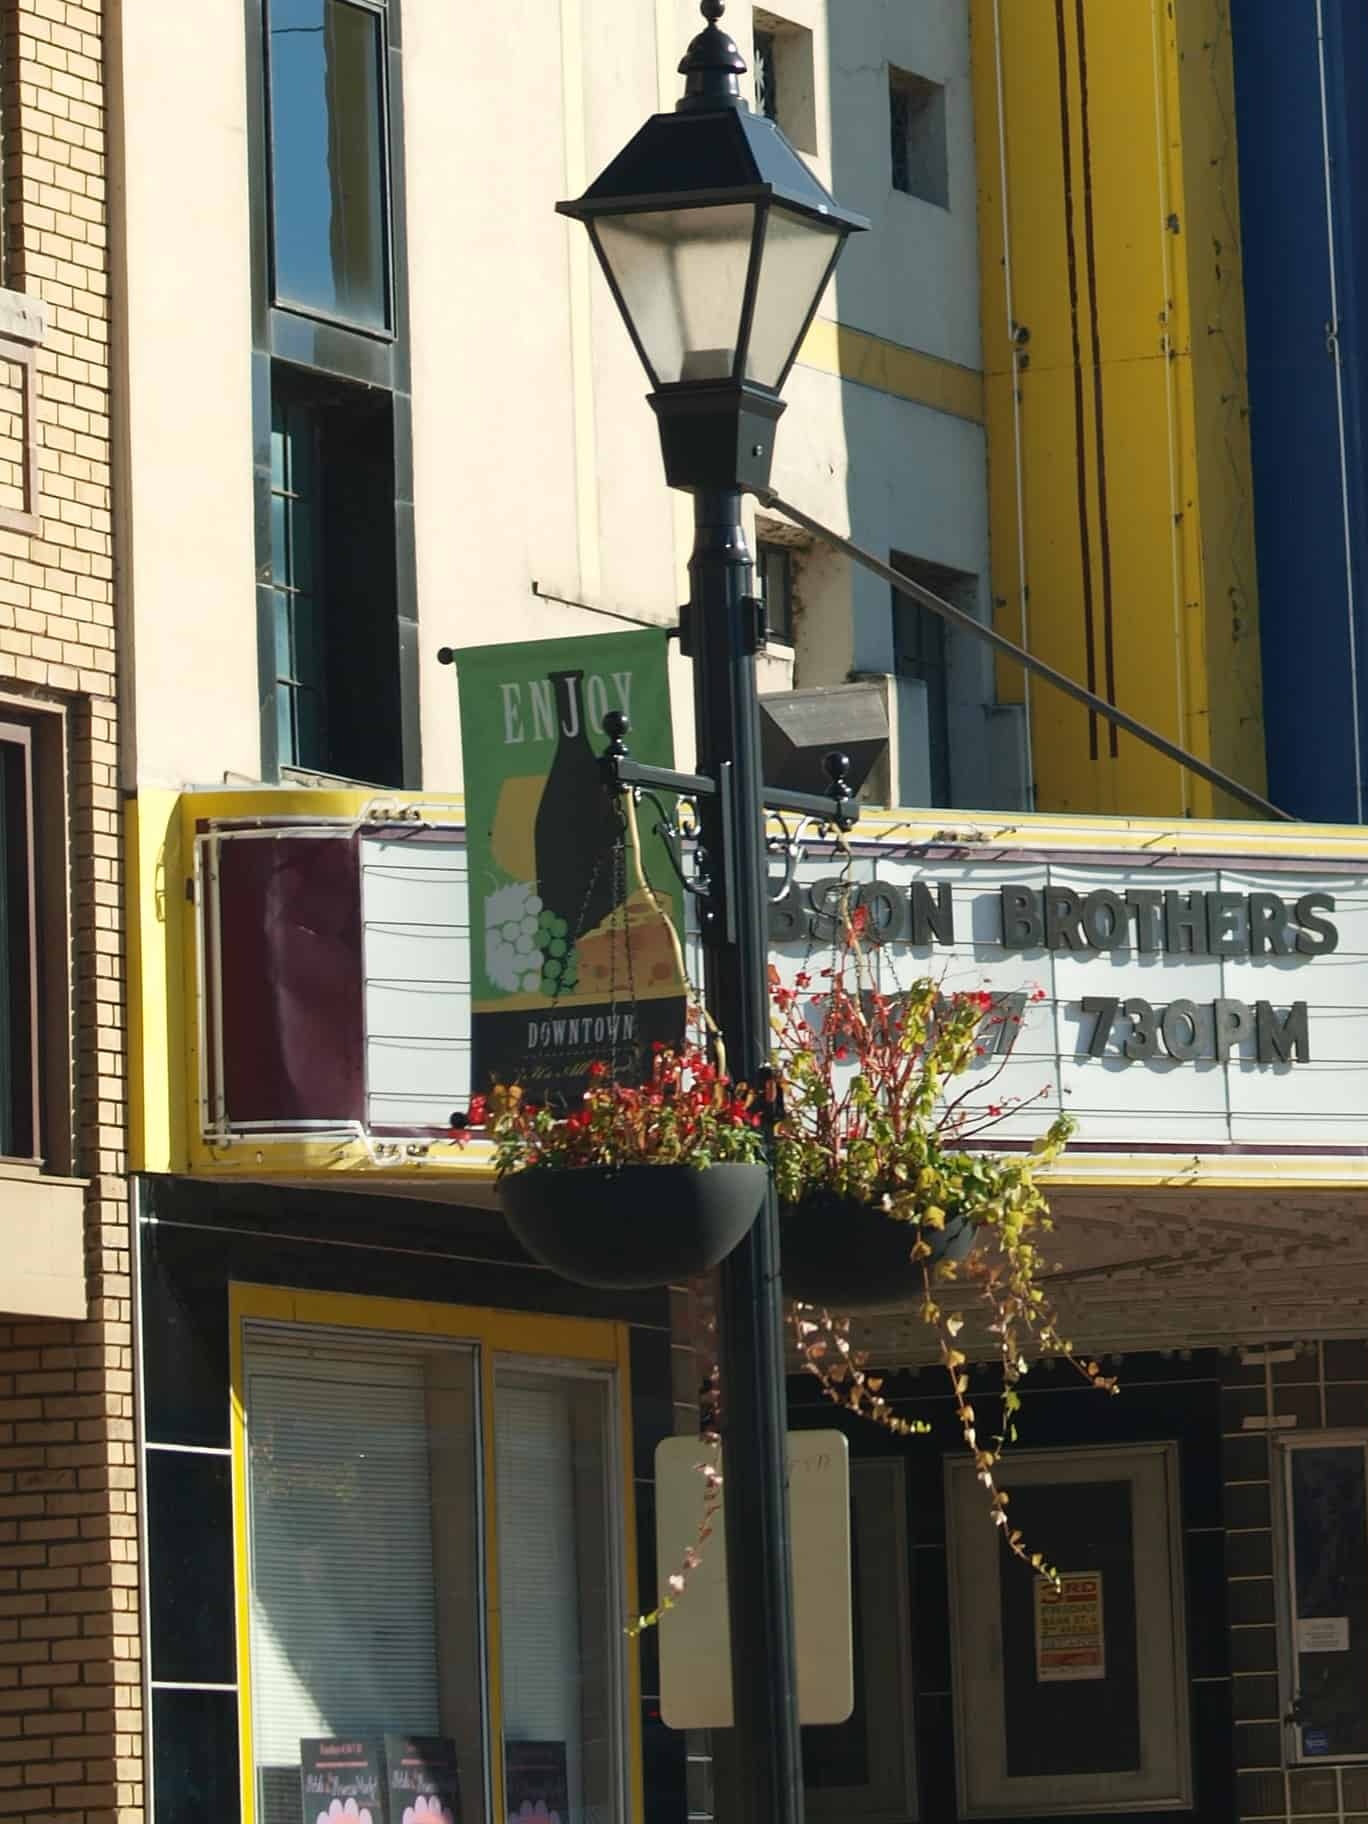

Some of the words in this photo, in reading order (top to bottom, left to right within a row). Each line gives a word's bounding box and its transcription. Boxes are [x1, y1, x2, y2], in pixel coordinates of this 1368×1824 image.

[499, 672, 633, 744] ENJOY
[1000, 884, 1338, 955] BROTHERS
[527, 1014, 635, 1049] DOWNTOWN
[1082, 996, 1310, 1064] 730PM
